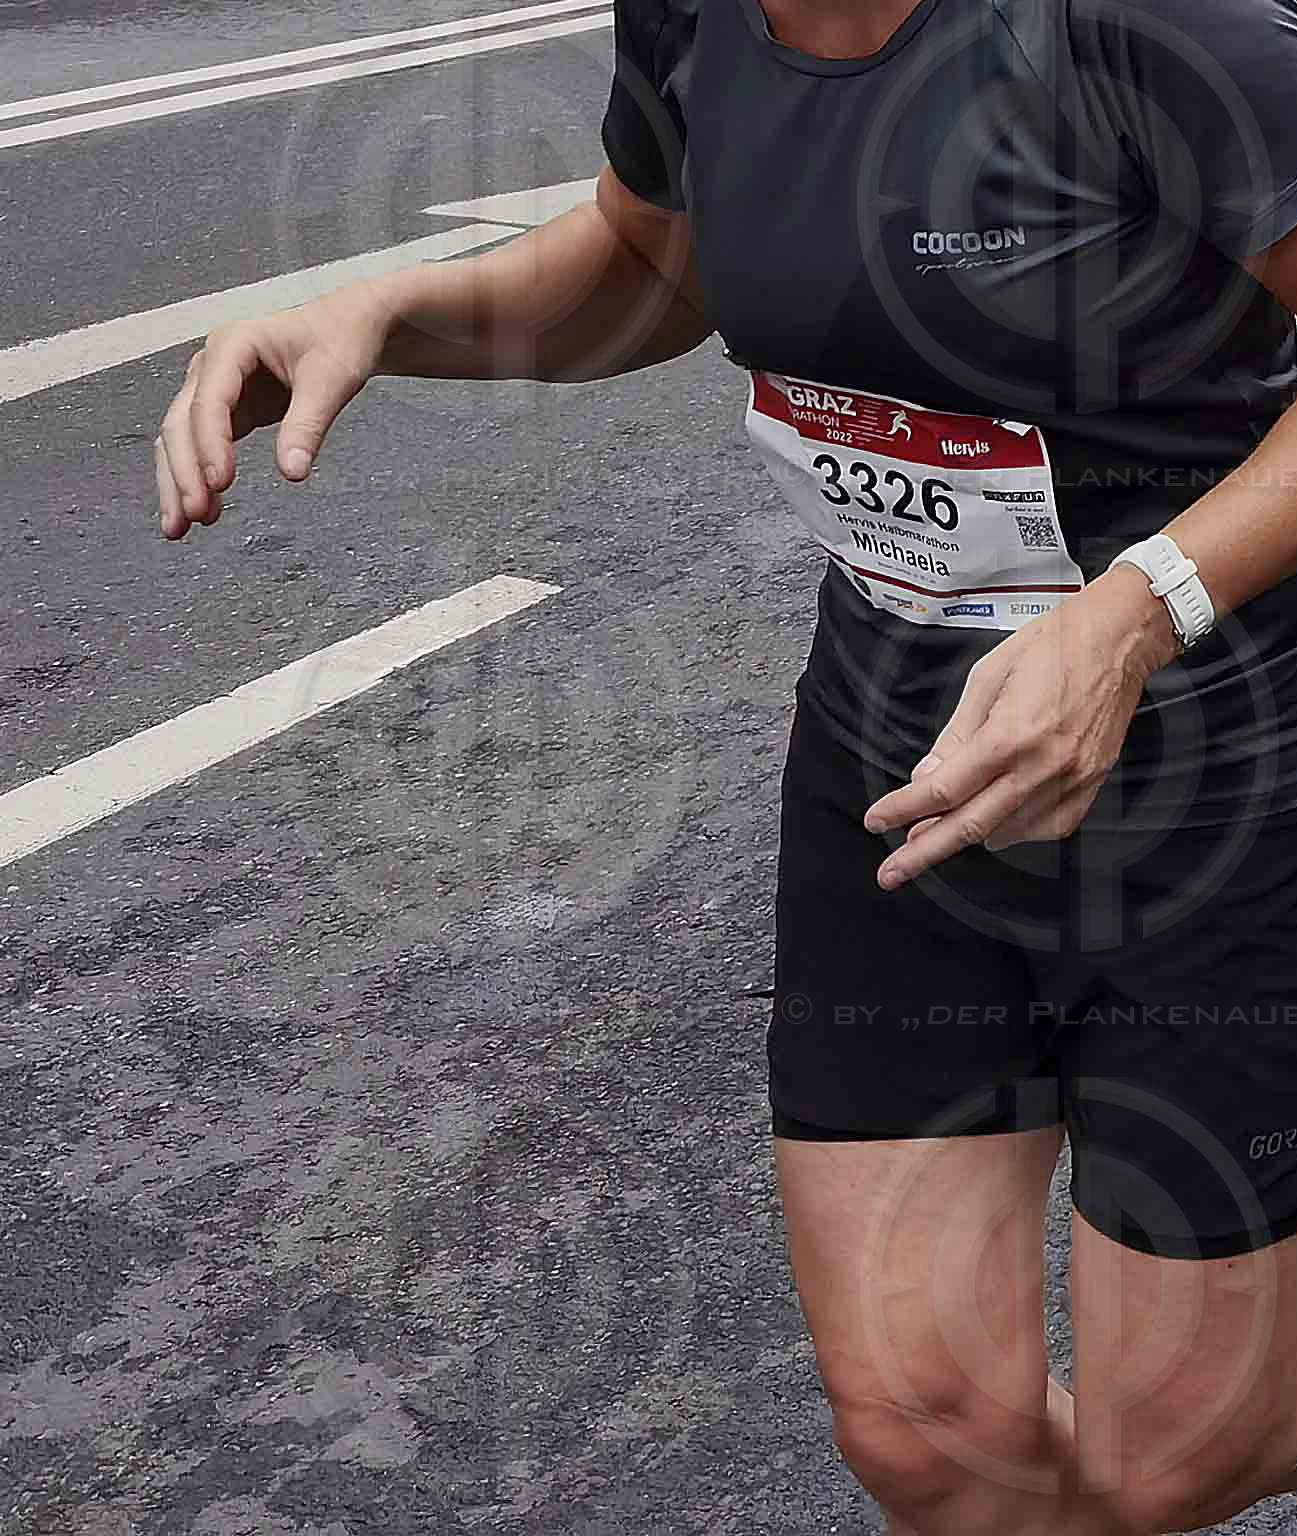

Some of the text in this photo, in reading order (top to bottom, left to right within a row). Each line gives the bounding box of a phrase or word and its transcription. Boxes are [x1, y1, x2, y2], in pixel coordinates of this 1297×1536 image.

[913, 225, 1026, 255] COCOON
[786, 385, 857, 417] GRAZ
[792, 409, 840, 428] RATHON
[826, 428, 853, 444] 2022
[940, 438, 991, 457] Hervis
[812, 452, 960, 531] 3326
[836, 513, 877, 529] Hervis
[850, 528, 951, 577] Michaela
